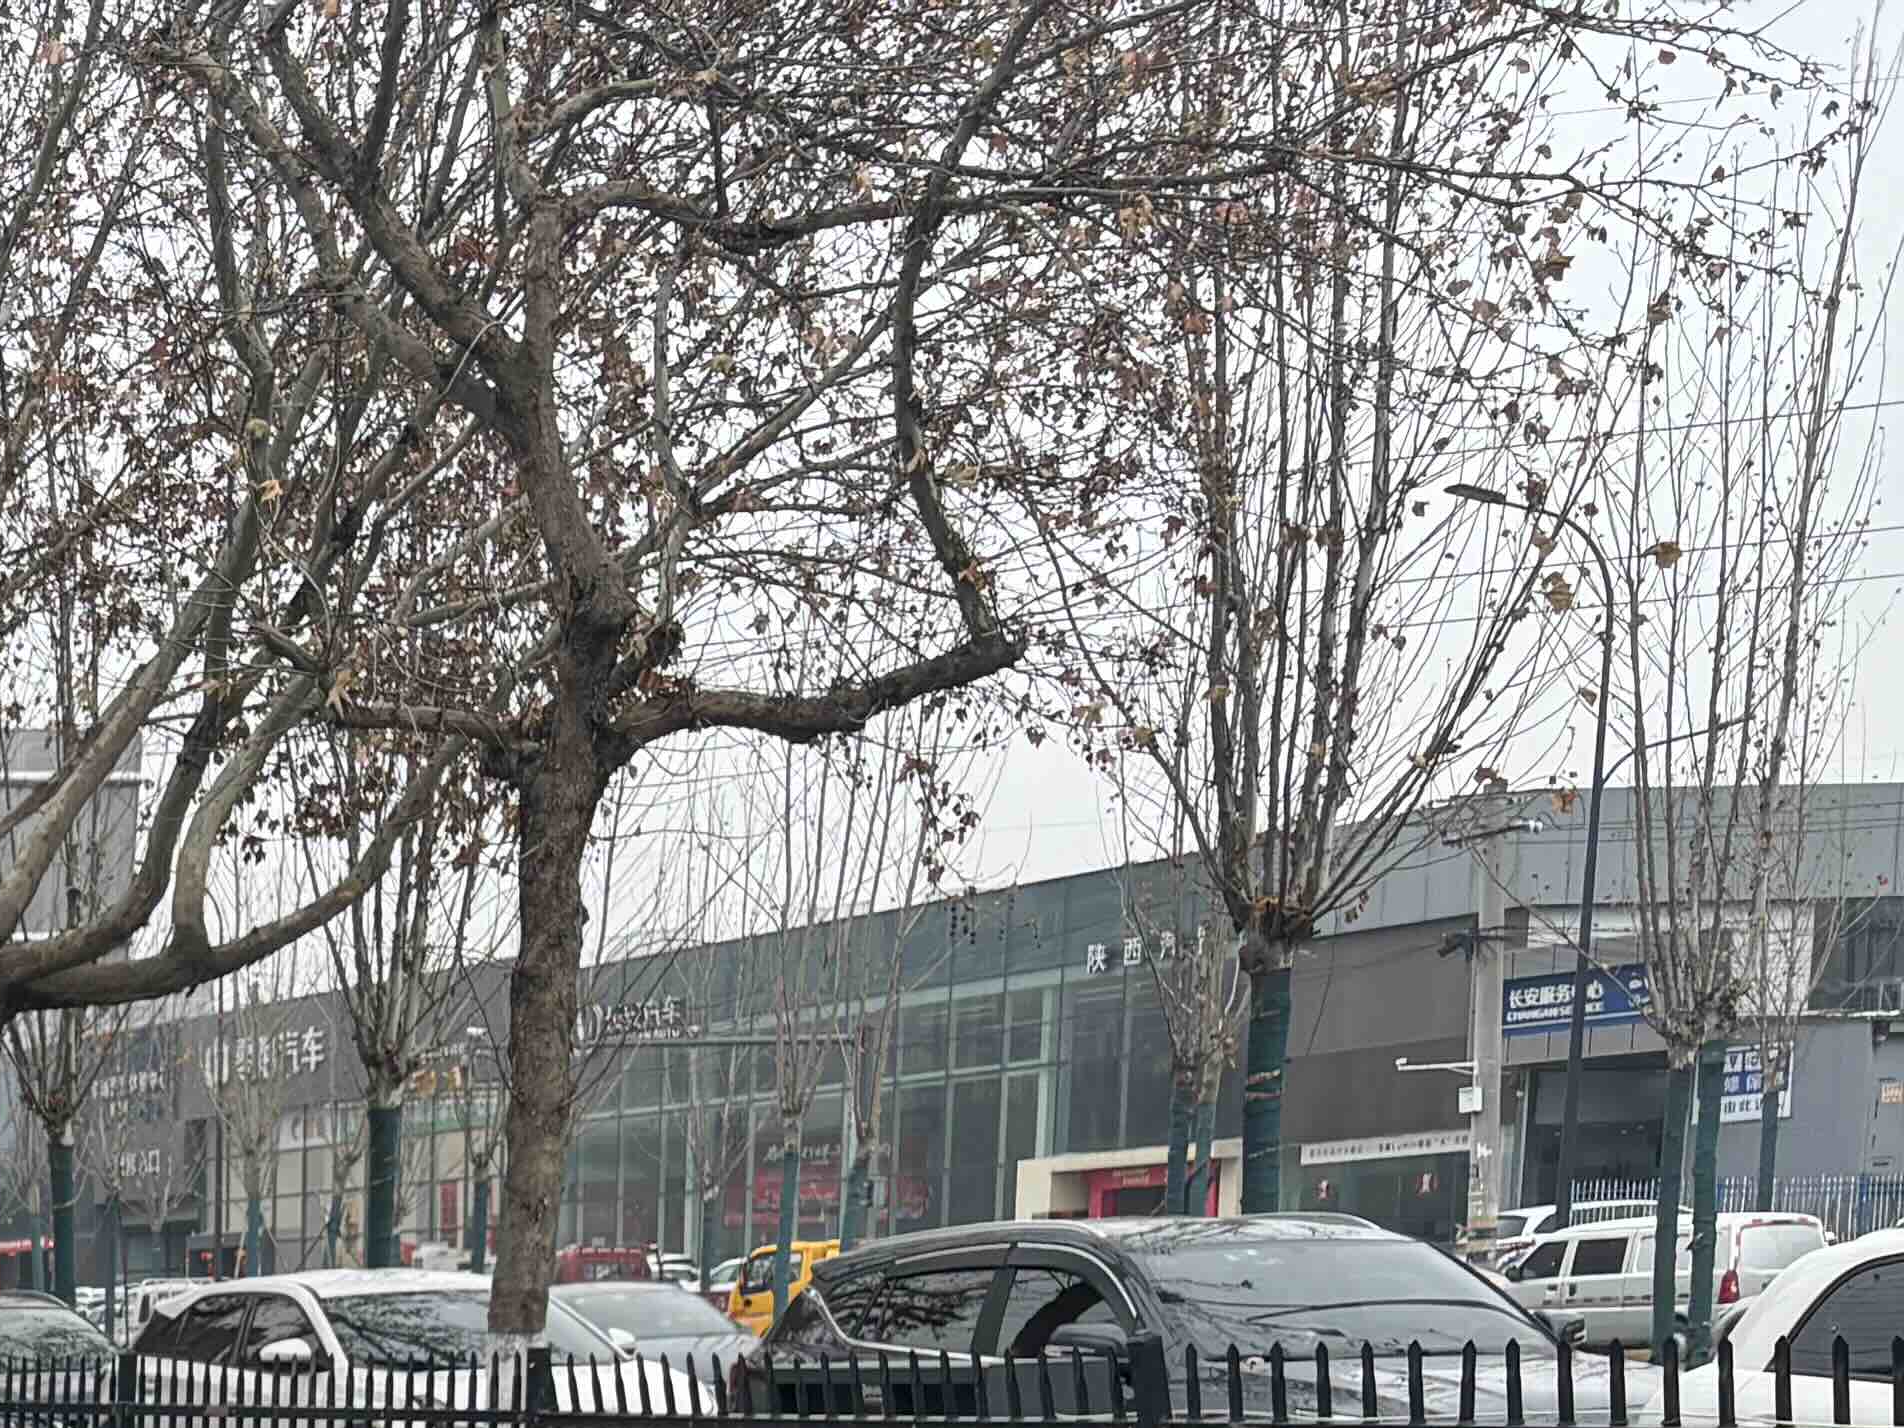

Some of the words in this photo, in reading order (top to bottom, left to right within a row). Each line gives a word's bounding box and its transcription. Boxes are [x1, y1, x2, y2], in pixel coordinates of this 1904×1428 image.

[1509, 979, 1605, 1009] 长安服务心
